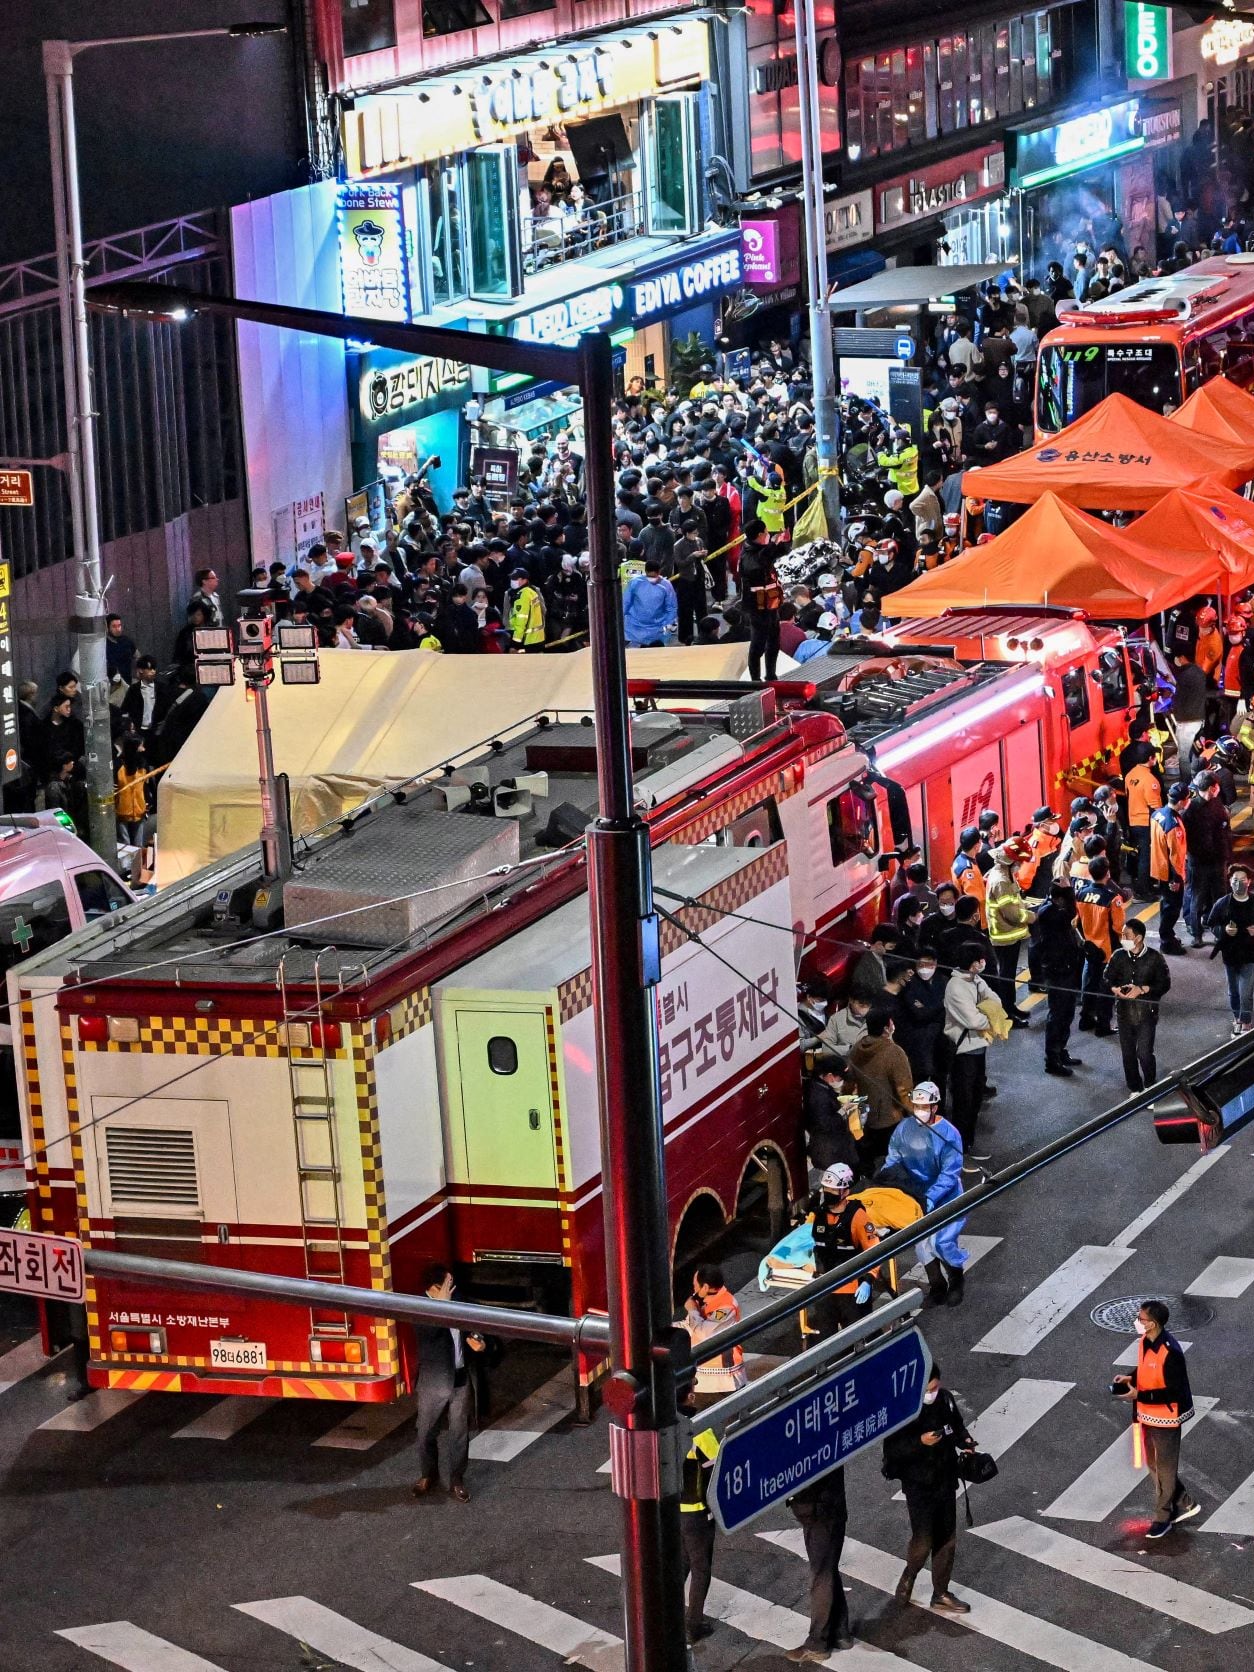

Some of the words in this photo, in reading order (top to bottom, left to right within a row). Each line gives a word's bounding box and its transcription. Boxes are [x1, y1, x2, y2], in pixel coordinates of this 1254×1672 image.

[1137, 2, 1159, 77] EDO
[743, 253, 765, 262] Pink
[635, 273, 681, 316] EDIYA
[681, 249, 740, 298] COFFEE
[1064, 347, 1099, 361] 119
[1065, 450, 1152, 465] 용산소방서
[961, 772, 995, 827] 119
[0, 1238, 78, 1294] 좌회전
[109, 1311, 162, 1325] 서울특별시
[166, 1314, 230, 1329] 소방재난본부
[213, 1349, 265, 1367] 98더6881
[891, 1358, 918, 1398] 177
[784, 1378, 860, 1445] 이태원로
[759, 1443, 831, 1501] Itaewon-ro
[840, 1405, 888, 1452] 梨泰院路
[724, 1459, 751, 1500] 181
